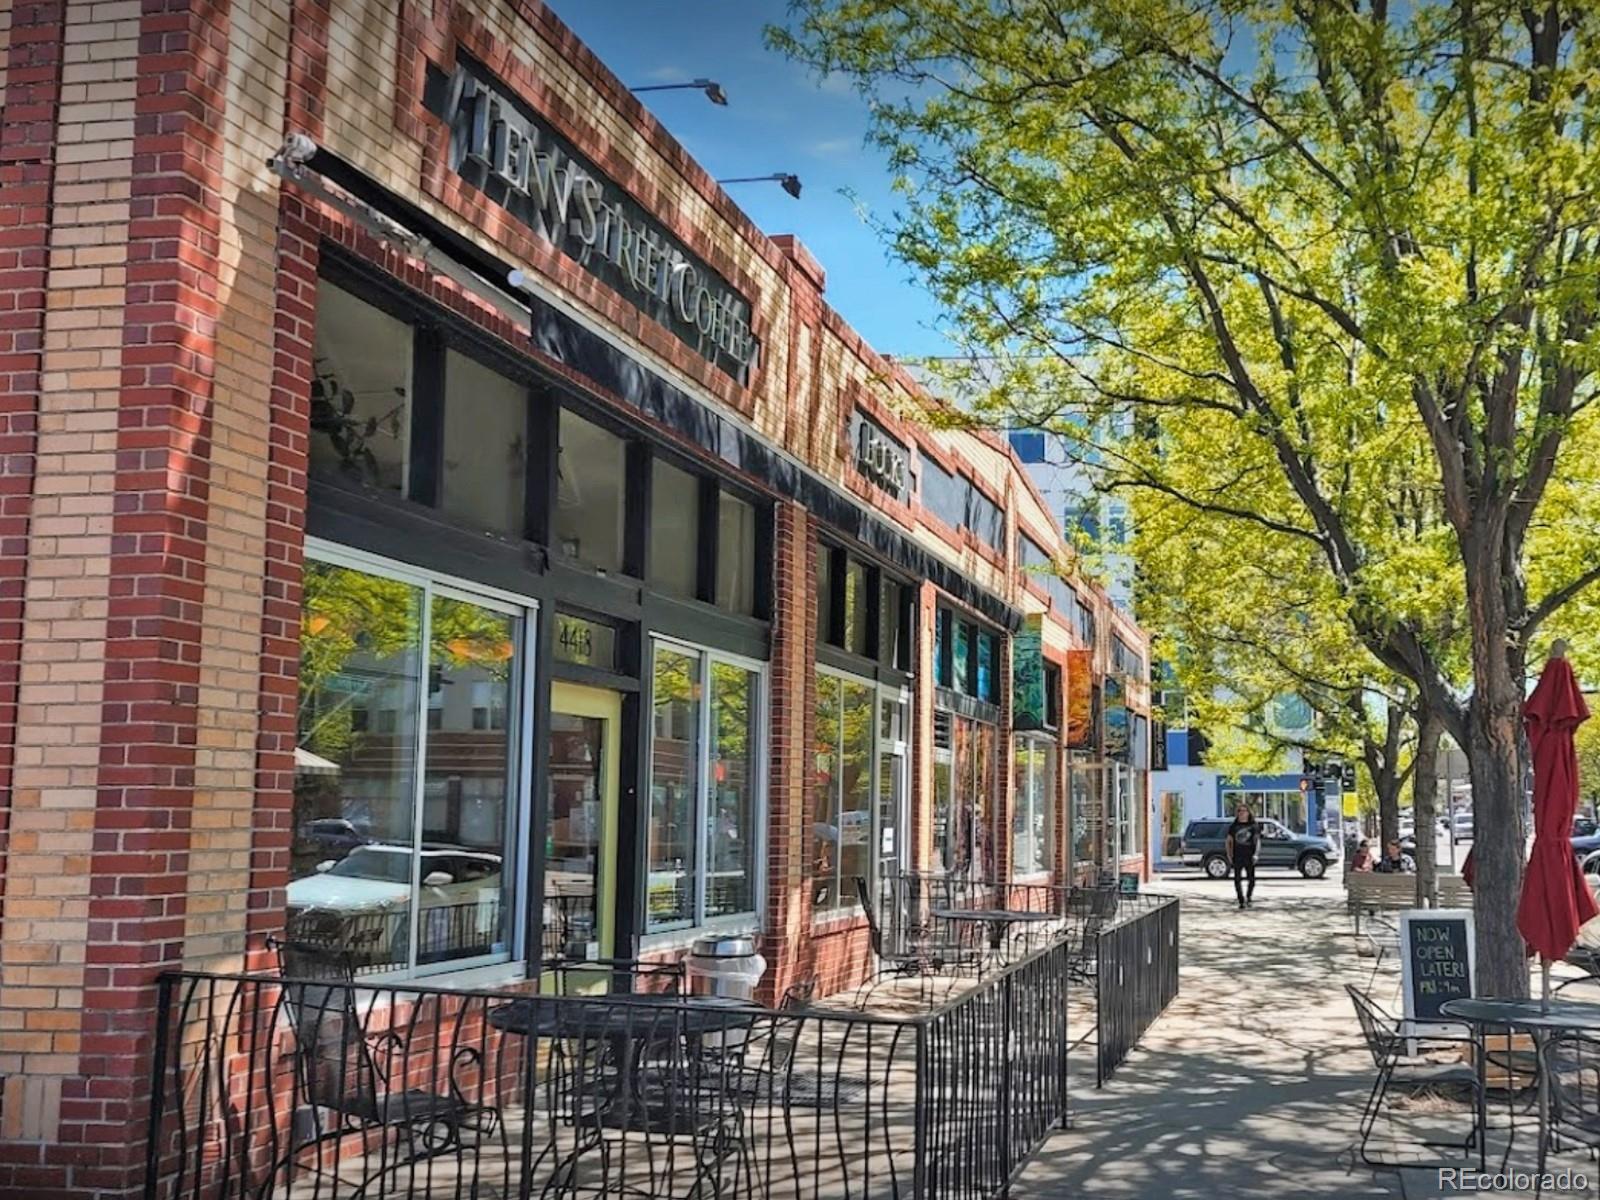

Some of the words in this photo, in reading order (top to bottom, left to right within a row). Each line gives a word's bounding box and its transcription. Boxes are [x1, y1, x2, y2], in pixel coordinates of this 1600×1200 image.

[1416, 926, 1450, 942] NOW
[1416, 944, 1455, 960] OPEN
[1420, 961, 1466, 978] LATER!
